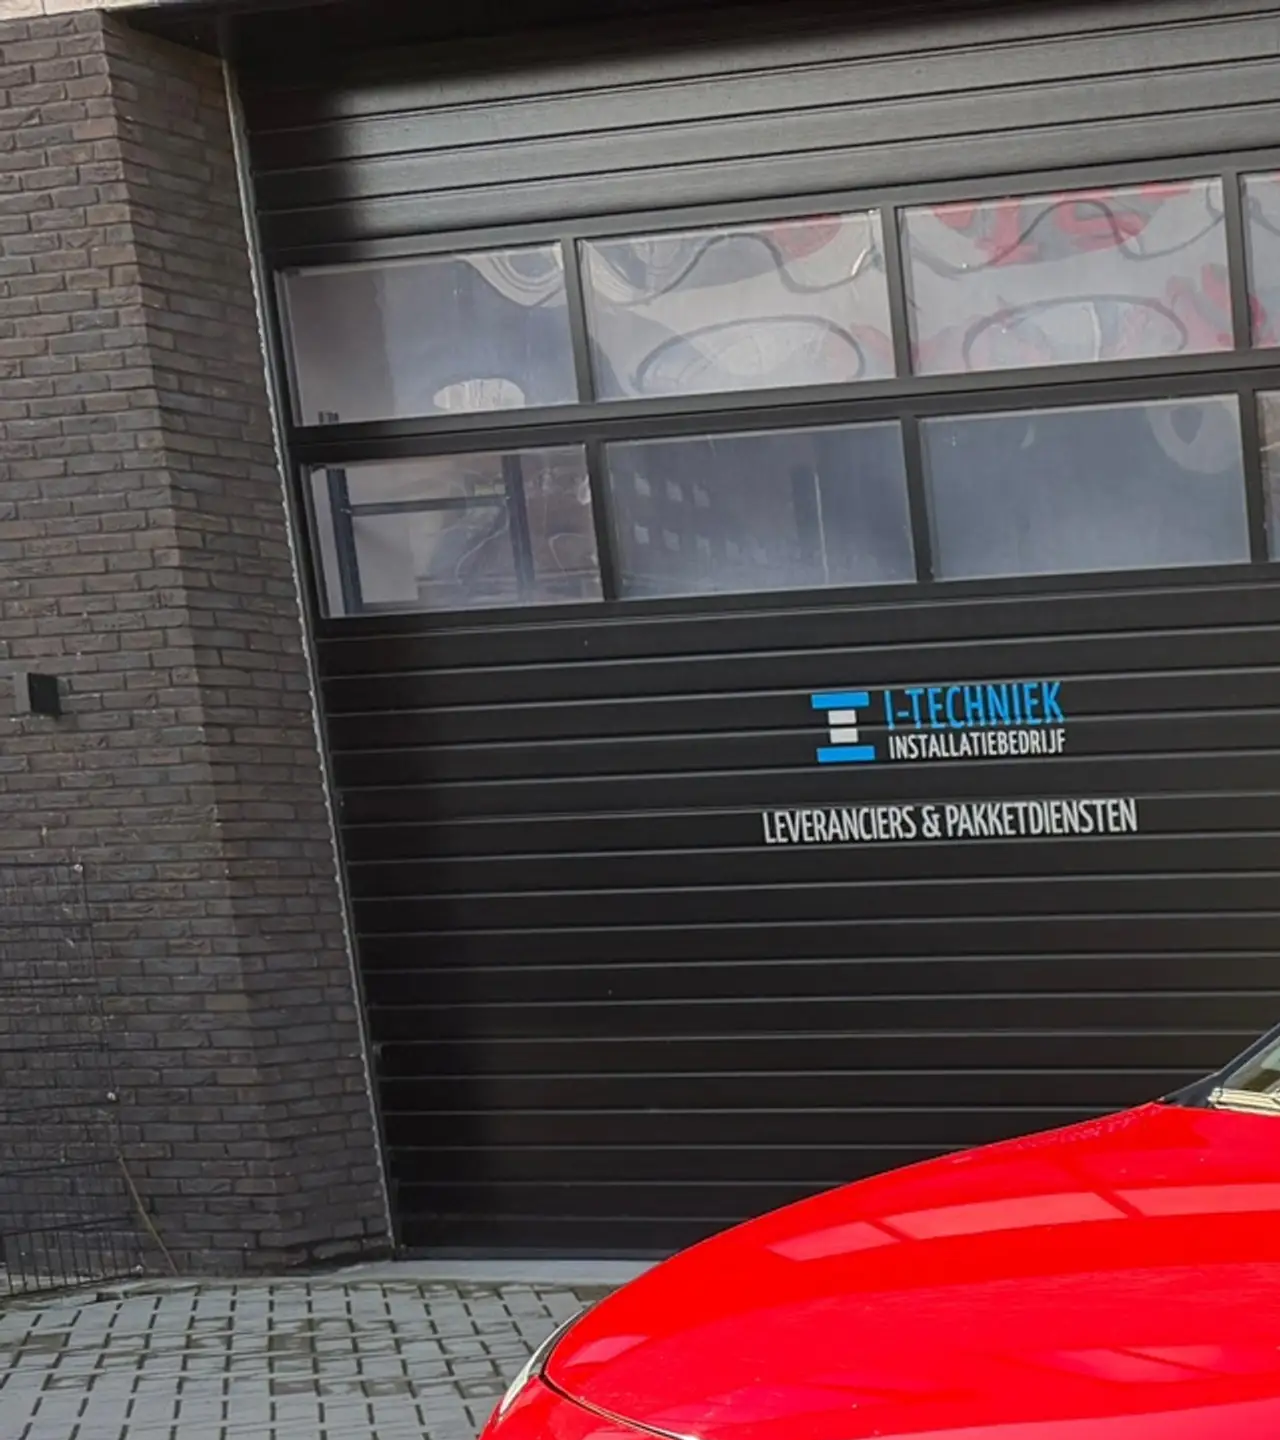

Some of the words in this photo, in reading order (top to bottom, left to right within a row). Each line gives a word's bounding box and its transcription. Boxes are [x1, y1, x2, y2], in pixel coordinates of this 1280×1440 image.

[884, 681, 1065, 731] I-TECHNIEK
[888, 728, 1066, 760] INSTALLATIEBEDRIJF
[762, 806, 916, 843] LEVERANCIERS
[921, 807, 942, 838] &
[946, 798, 1138, 837] PAKKETDIENSTEN
